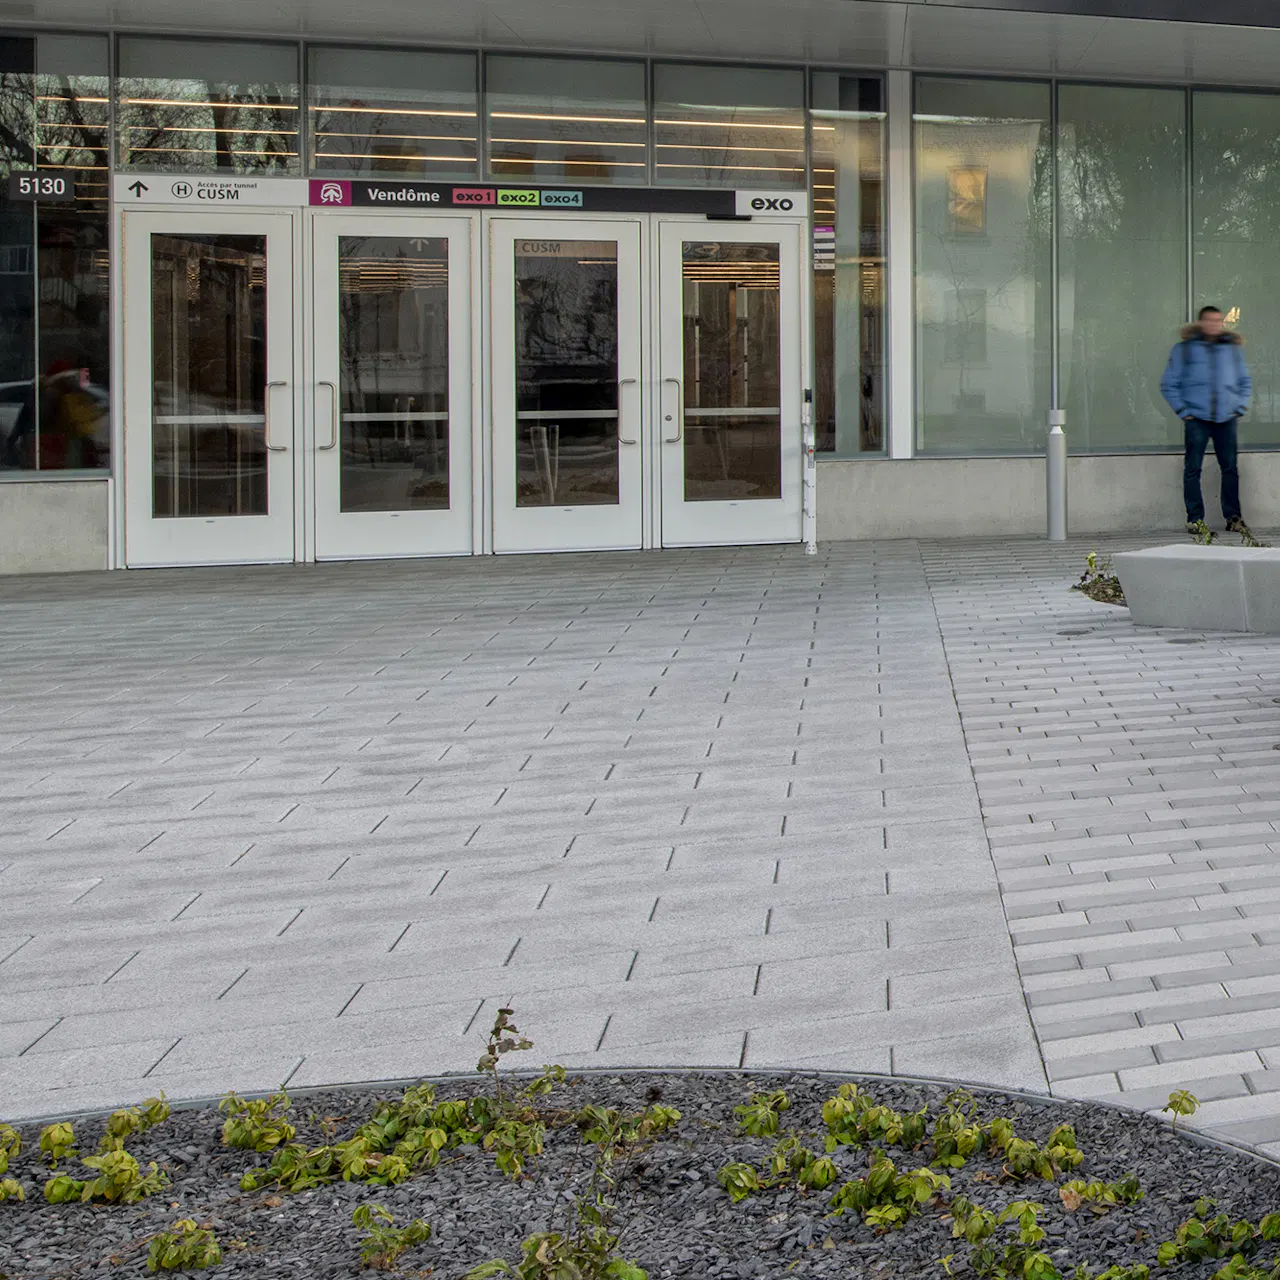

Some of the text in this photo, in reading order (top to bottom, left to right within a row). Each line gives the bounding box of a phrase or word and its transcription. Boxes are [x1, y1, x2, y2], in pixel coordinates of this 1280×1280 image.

[19, 177, 66, 196] 5130
[197, 181, 218, 189] Accès
[219, 182, 232, 190] par
[197, 188, 240, 200] CUSM
[367, 187, 440, 203] Vendôme
[501, 192, 537, 203] exo2
[544, 193, 580, 205] exo4
[750, 197, 794, 211] exo
[522, 242, 561, 254] CUSM
